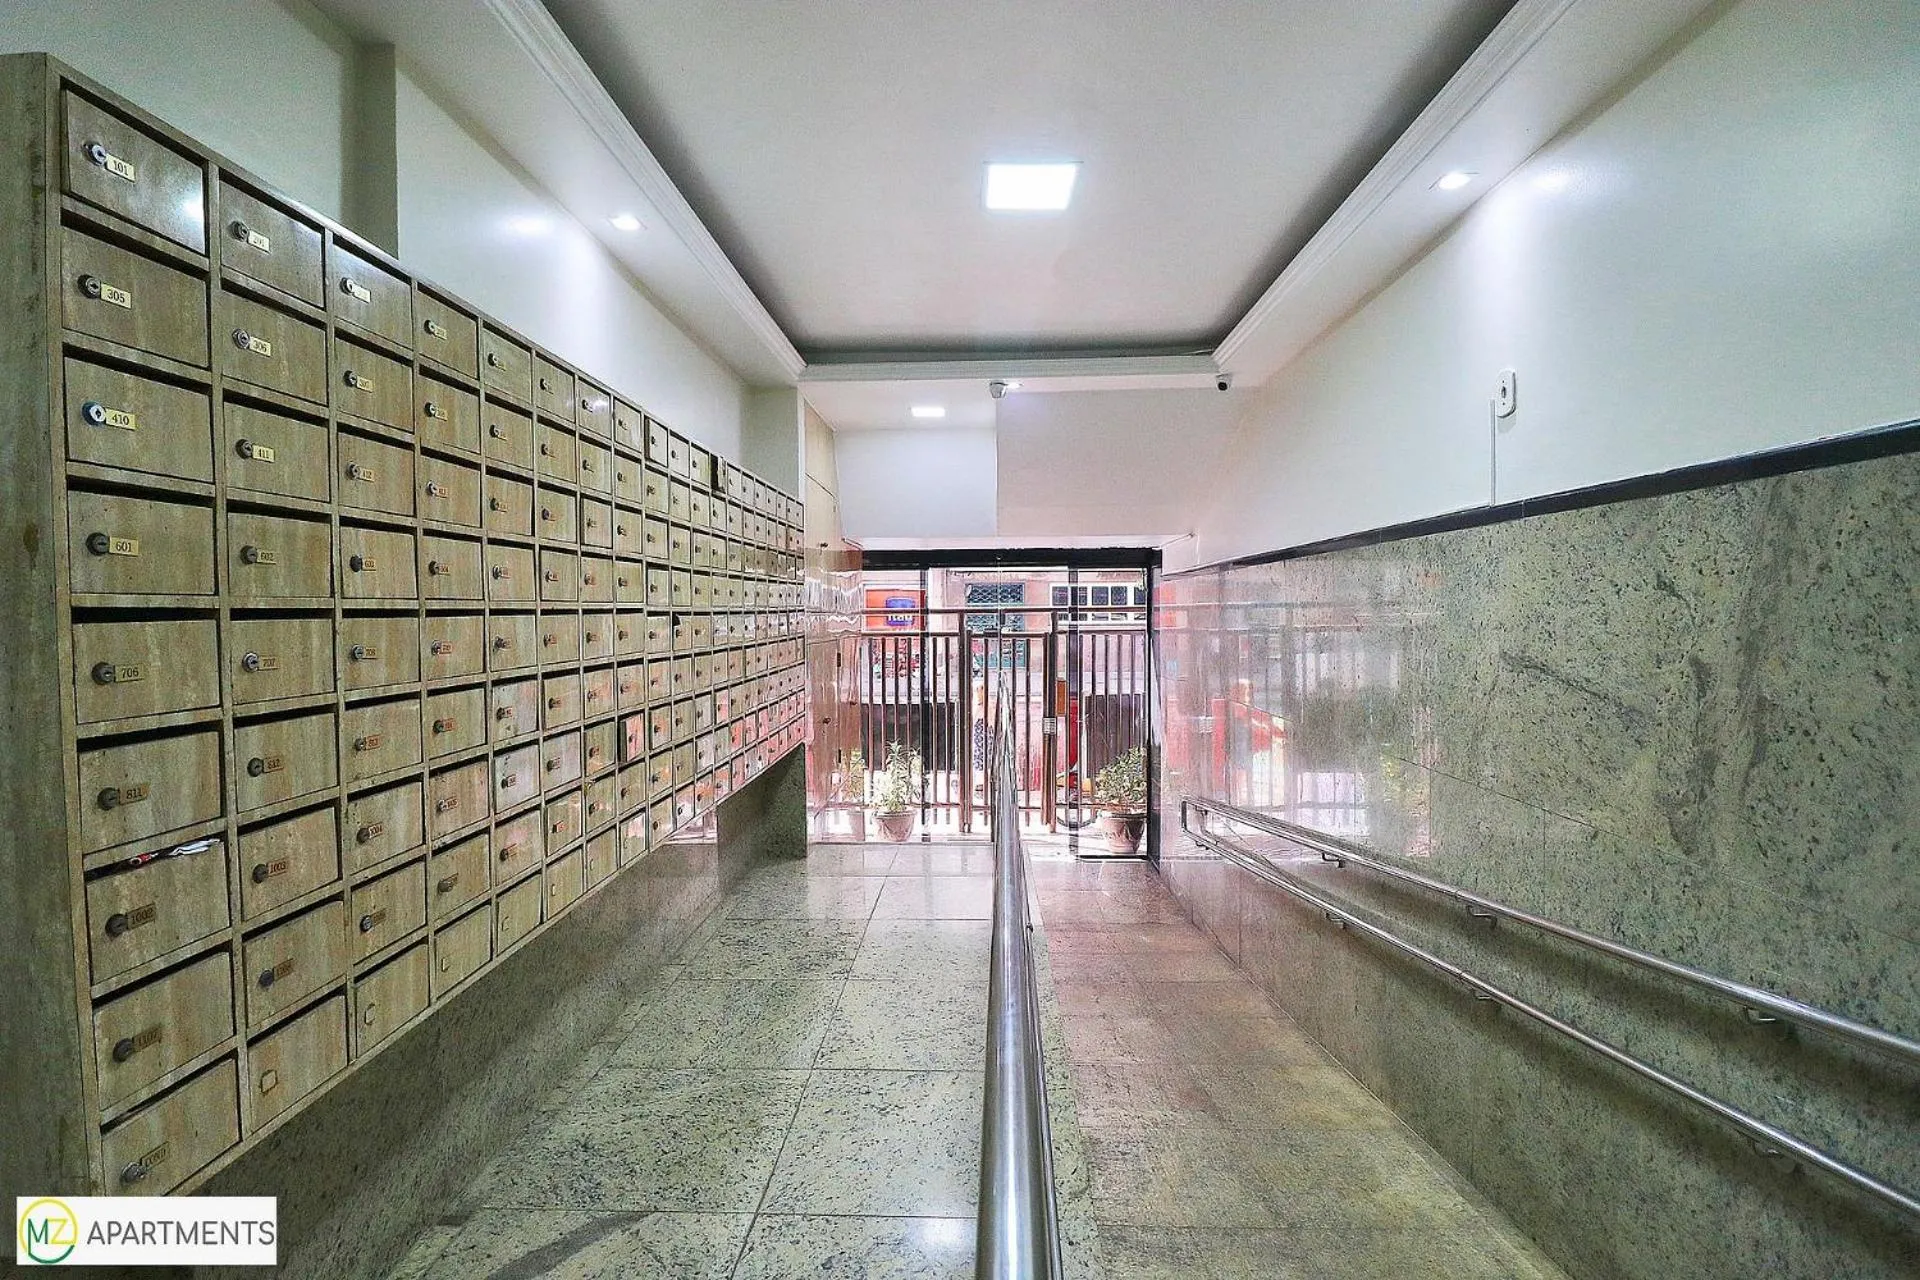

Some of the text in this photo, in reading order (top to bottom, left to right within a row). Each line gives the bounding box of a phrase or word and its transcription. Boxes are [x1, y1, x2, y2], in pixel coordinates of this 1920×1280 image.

[113, 160, 129, 176] 101
[107, 289, 125, 303] 305
[112, 413, 130, 426] 410
[116, 541, 132, 552] 601
[121, 667, 139, 678] 706
[126, 787, 142, 799] 811
